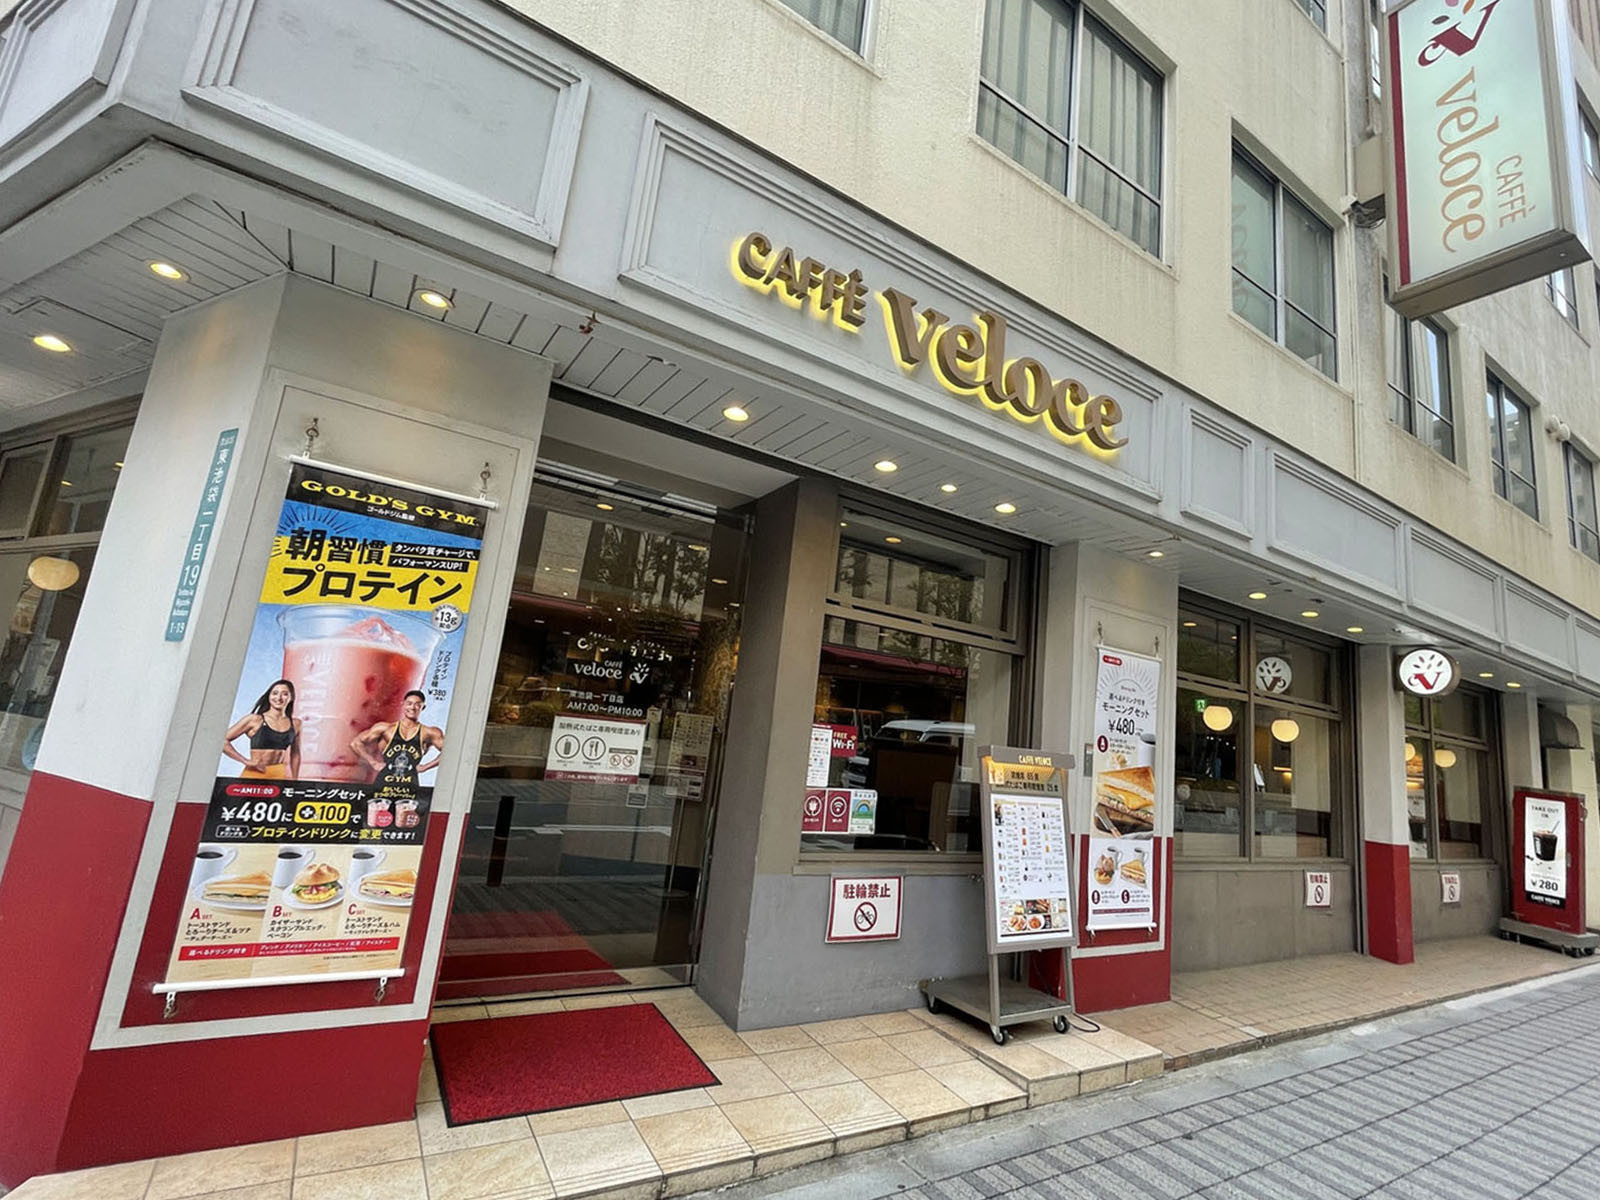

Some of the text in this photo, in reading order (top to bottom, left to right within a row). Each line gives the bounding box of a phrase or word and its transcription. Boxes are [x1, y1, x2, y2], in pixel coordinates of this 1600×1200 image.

[301, 480, 408, 511] GOLD'S
[285, 527, 388, 567] 朝習慣
[183, 564, 200, 586] 19
[282, 564, 463, 605] プロテイン
[573, 662, 622, 680] veloce
[1108, 718, 1135, 736] ¥480
[282, 788, 366, 800] モーニングセット
[843, 883, 891, 900] 駐輪禁止
[190, 908, 201, 920] A
[272, 905, 282, 918] B
[348, 904, 357, 915] C
